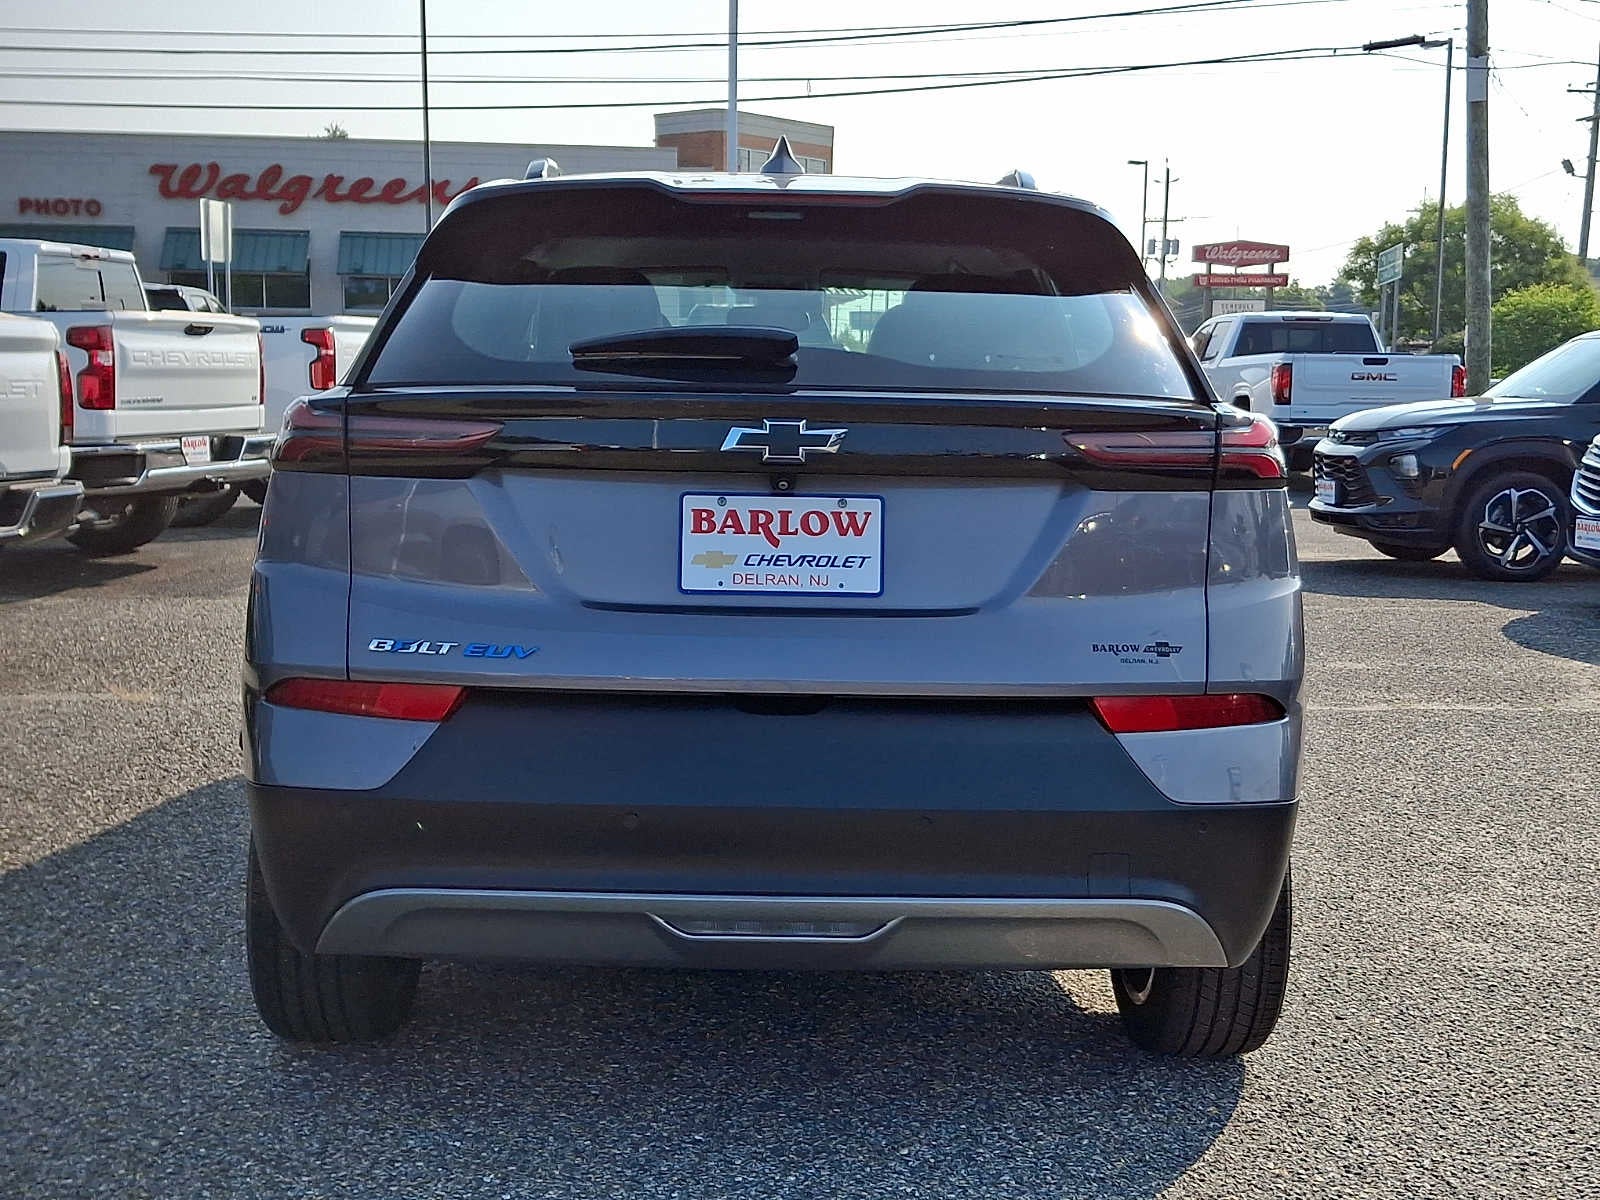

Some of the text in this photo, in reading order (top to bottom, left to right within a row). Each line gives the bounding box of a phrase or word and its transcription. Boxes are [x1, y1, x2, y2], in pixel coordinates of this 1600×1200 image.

[18, 197, 102, 217] PHOTO
[1204, 245, 1281, 263] Walgreens
[132, 350, 257, 368] CHEVROLET
[1350, 372, 1398, 382] GMC
[690, 508, 873, 549] BARLOW
[743, 553, 872, 569] CHEVROLET
[731, 572, 830, 588] DELRAN, NJ
[368, 638, 540, 660] BOLT EUV
[1092, 643, 1141, 656] BARLOW
